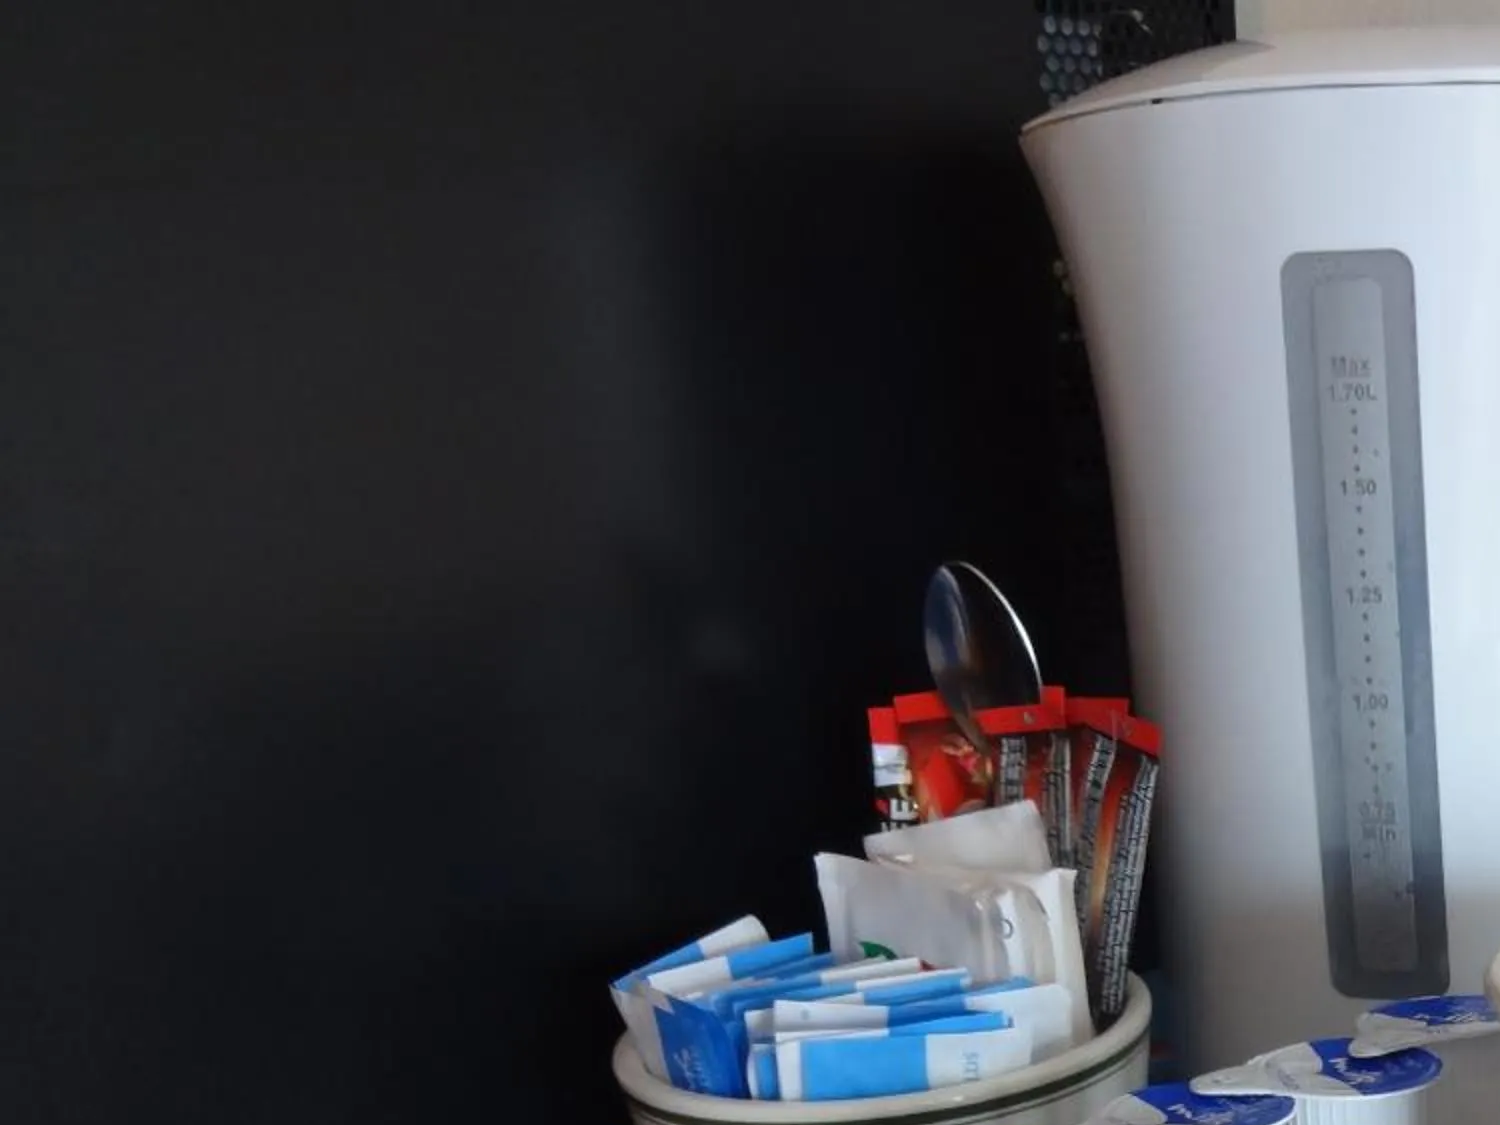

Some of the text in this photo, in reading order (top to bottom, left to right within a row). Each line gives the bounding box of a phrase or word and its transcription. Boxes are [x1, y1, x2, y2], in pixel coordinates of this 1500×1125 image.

[1326, 383, 1378, 402] 1.70L
[1340, 479, 1377, 497] 1.50
[1353, 694, 1389, 712] 1.00
